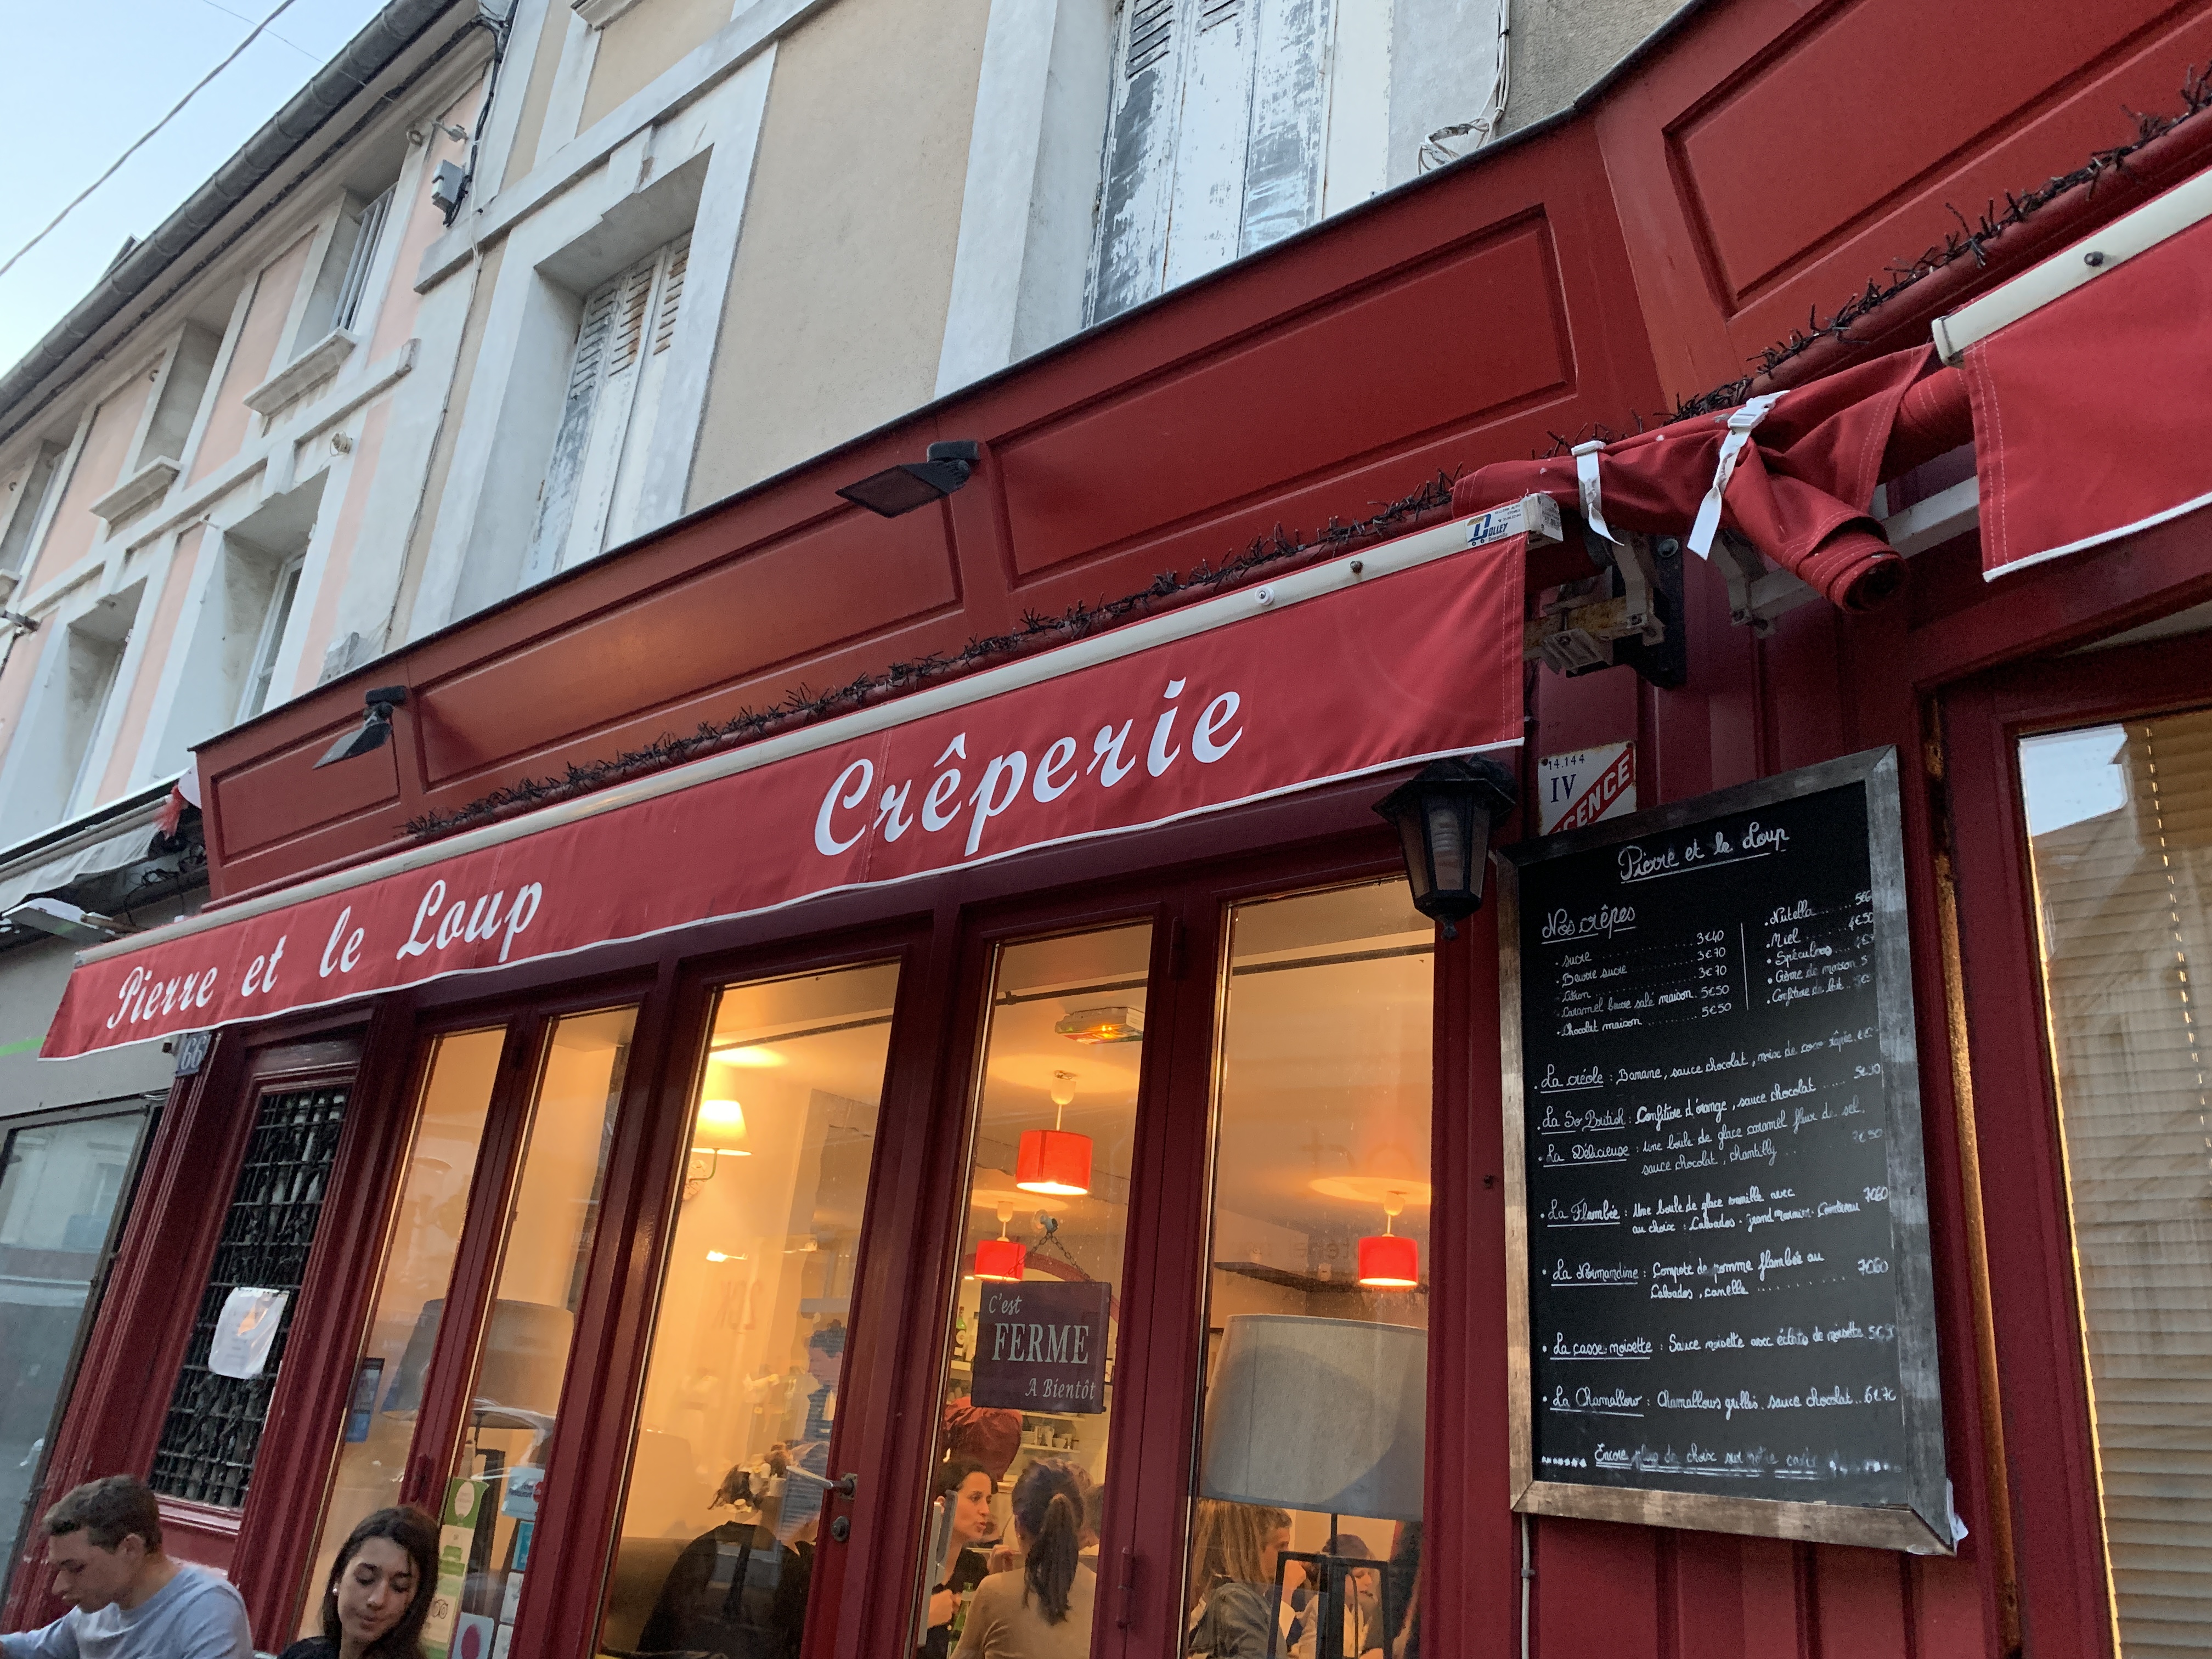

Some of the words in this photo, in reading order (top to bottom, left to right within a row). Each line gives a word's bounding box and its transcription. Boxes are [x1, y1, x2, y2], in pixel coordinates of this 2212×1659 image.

[815, 676, 1243, 856] Crêperie
[1548, 754, 1585, 770] 14.144
[1550, 774, 1577, 803] IV
[1618, 845, 1679, 881] Pierre
[1685, 838, 1705, 862] et
[1713, 831, 1733, 856] le
[1742, 822, 1790, 851] Loup
[1542, 909, 1576, 939] Nos
[1578, 904, 1636, 940] crêpes
[1770, 899, 1816, 925] Nutella
[106, 966, 218, 1029] Pierre
[241, 934, 287, 997] et
[319, 905, 365, 978] le
[396, 879, 543, 964] Loup
[1561, 951, 1592, 968] sucre
[1696, 929, 1725, 945] 3€40
[1771, 927, 1801, 948] Miel
[1561, 969, 1598, 988] Beurre
[1600, 964, 1627, 979] sucre
[1697, 947, 1726, 961] 3€70
[1562, 990, 1592, 1003] Citron
[1699, 965, 1728, 979] 3€70
[1561, 997, 1604, 1018] Caramel
[1634, 991, 1655, 1009] salé
[1701, 985, 1730, 999] 5€50
[1561, 1019, 1599, 1036] Chocolat
[1601, 1017, 1643, 1031] maison
[1702, 1002, 1732, 1018] 5€50
[180, 1035, 207, 1070] 66
[1541, 1064, 1564, 1088] La
[1566, 1065, 1604, 1086] créole
[1670, 1065, 1703, 1077] sauce
[1758, 1048, 1782, 1063] noix
[1784, 1039, 1798, 1058] de
[1542, 1105, 1560, 1127] La
[1564, 1110, 1583, 1128] So
[1581, 1107, 1627, 1132] British
[1635, 1103, 1683, 1132] Confiture
[1736, 1093, 1767, 1108] sauce
[1770, 1076, 1817, 1102] chocolat
[1545, 1143, 1565, 1163] La
[1572, 1142, 1630, 1160] Délicieuse
[1666, 1130, 1694, 1150] boule
[1697, 1127, 1713, 1146] de
[1718, 1124, 1743, 1150] glace
[1746, 1109, 1788, 1136] caramel
[1641, 1163, 1672, 1176] sauce
[1729, 1138, 1778, 1167] chantilly
[1548, 1198, 1568, 1220] La
[1571, 1197, 1621, 1222] Flambée
[1633, 1202, 1652, 1217] Une
[1656, 1195, 1684, 1215] boule
[1685, 1194, 1697, 1212] de
[1701, 1192, 1724, 1218] glace
[1728, 1185, 1765, 1206] vanille
[1770, 1188, 1796, 1200] avec
[1632, 1226, 1646, 1234] au
[1648, 1219, 1676, 1233] choix
[1689, 1213, 1735, 1231] Calvados
[1553, 1258, 1572, 1280] La
[1652, 1261, 1694, 1284] Compote
[1697, 1257, 1707, 1275] de
[1713, 1260, 1754, 1284] pomme
[1807, 1252, 1825, 1263] au
[989, 1293, 1023, 1316] C'est
[991, 1323, 1089, 1364] FERME
[1553, 1331, 1571, 1355] La
[1668, 1333, 1701, 1353] Sauce
[1705, 1331, 1745, 1351] noisette
[1750, 1336, 1774, 1347] avec
[1813, 1325, 1825, 1342] de
[1025, 1378, 1037, 1397] A
[1042, 1378, 1096, 1400] Bientôt
[1553, 1385, 1570, 1407] La
[1575, 1386, 1643, 1407] Chamallow
[1657, 1389, 1722, 1410] Chamallows
[1767, 1395, 1802, 1410] sauce
[1806, 1385, 1854, 1407] chocolat
[1594, 1442, 1629, 1462] Encore
[1686, 1442, 1718, 1463] choix
